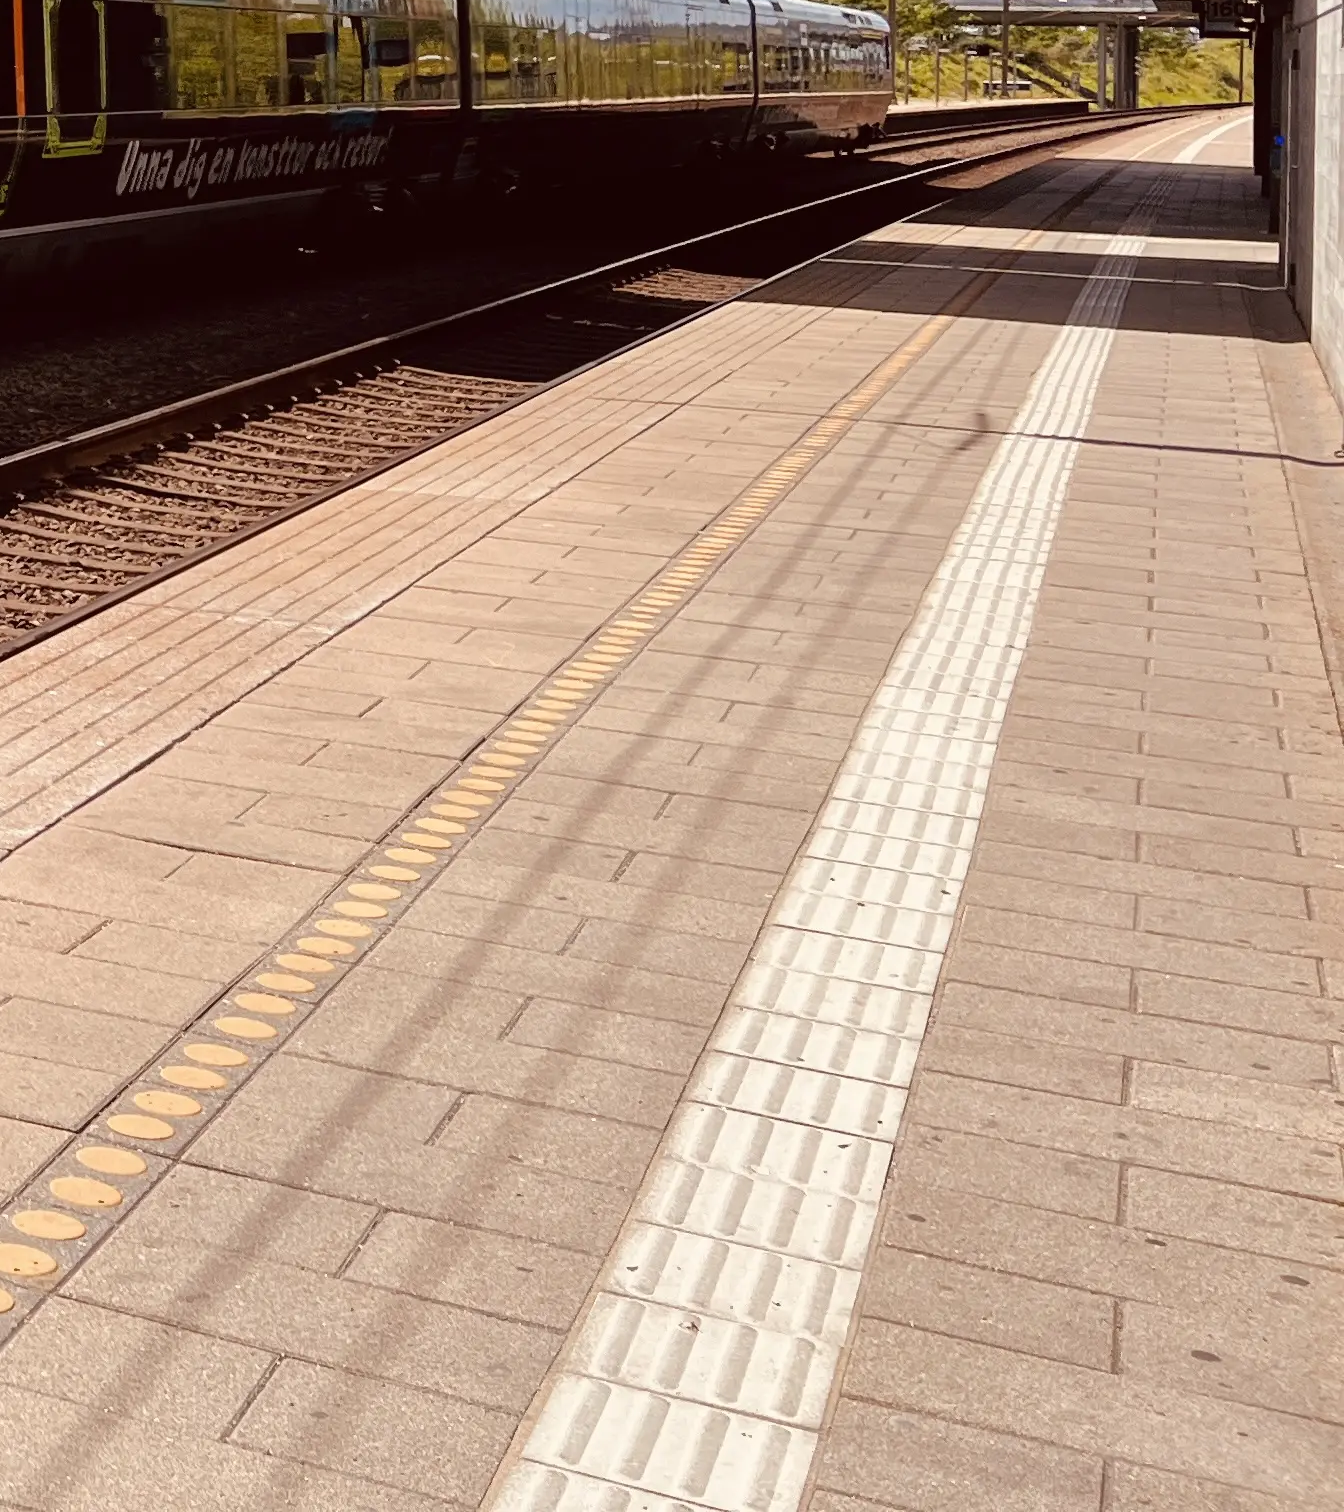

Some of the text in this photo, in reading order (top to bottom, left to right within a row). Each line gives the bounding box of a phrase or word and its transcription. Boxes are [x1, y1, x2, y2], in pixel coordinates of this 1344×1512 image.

[116, 140, 174, 196] Unna
[174, 137, 209, 200] dig
[208, 147, 235, 185] en
